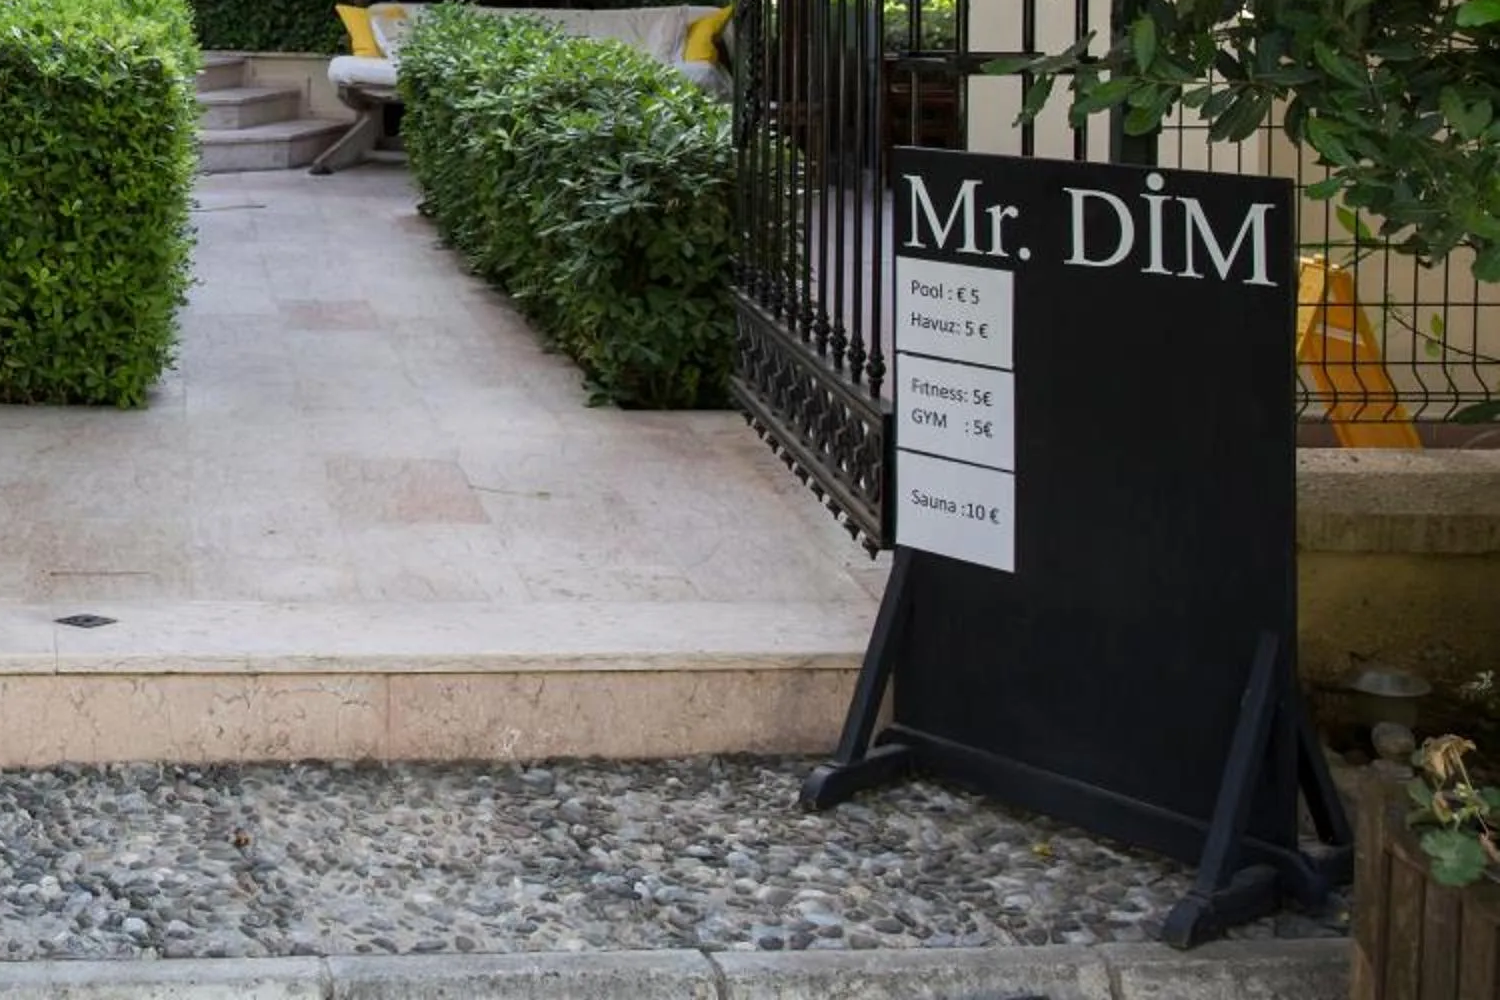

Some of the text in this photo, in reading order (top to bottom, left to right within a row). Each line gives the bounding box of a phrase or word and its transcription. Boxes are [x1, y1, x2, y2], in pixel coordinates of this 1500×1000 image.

[903, 172, 1279, 287] Mr. DİM
[910, 279, 943, 299] Pool
[971, 289, 980, 305] 5
[910, 312, 961, 335] Havuz:
[965, 321, 975, 337] 5
[910, 377, 968, 403] Fitness:
[910, 408, 948, 429] GYM
[910, 489, 957, 513] Sauna
